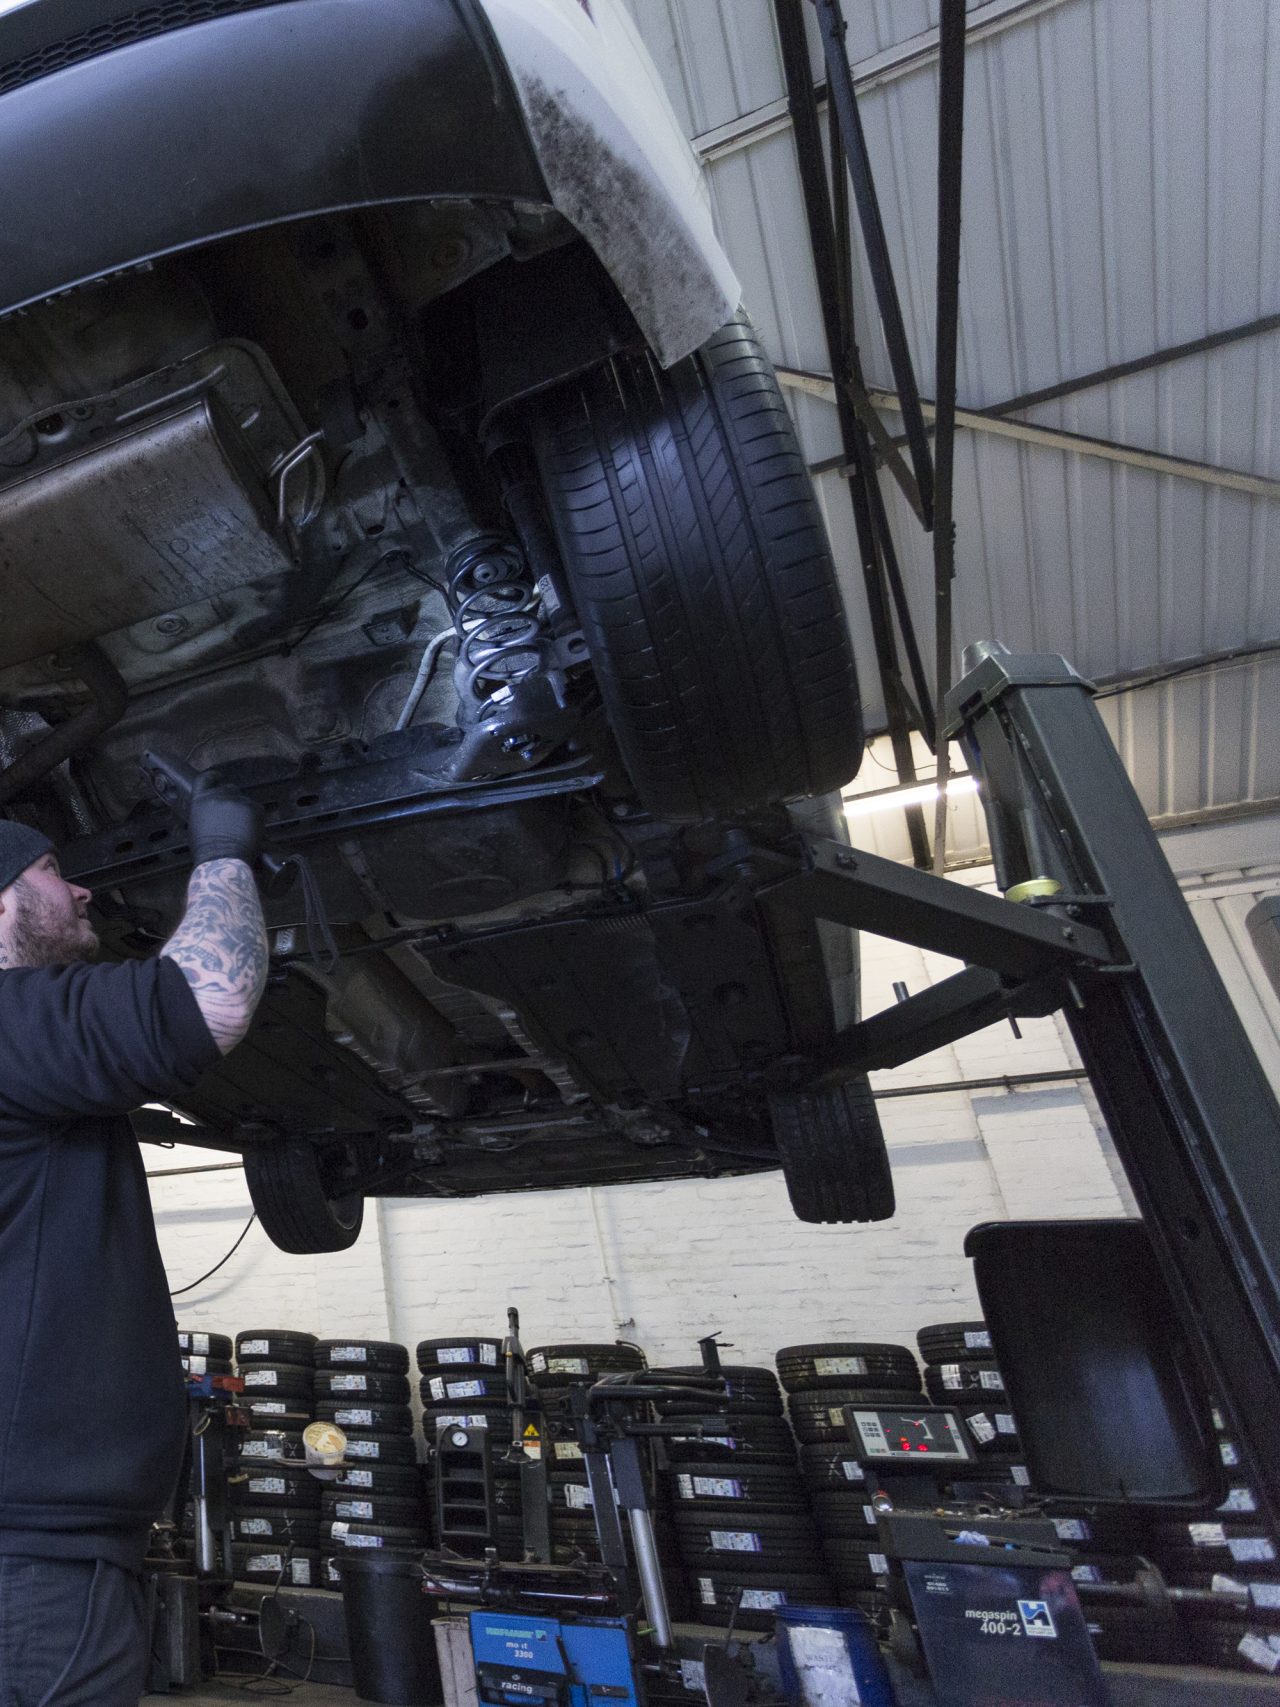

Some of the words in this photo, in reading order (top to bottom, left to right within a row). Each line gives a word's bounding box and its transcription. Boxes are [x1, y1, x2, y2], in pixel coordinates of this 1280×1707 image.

[965, 1609, 1018, 1622] megaspin
[980, 1621, 1022, 1636] 400-2
[501, 1681, 533, 1695] racing
